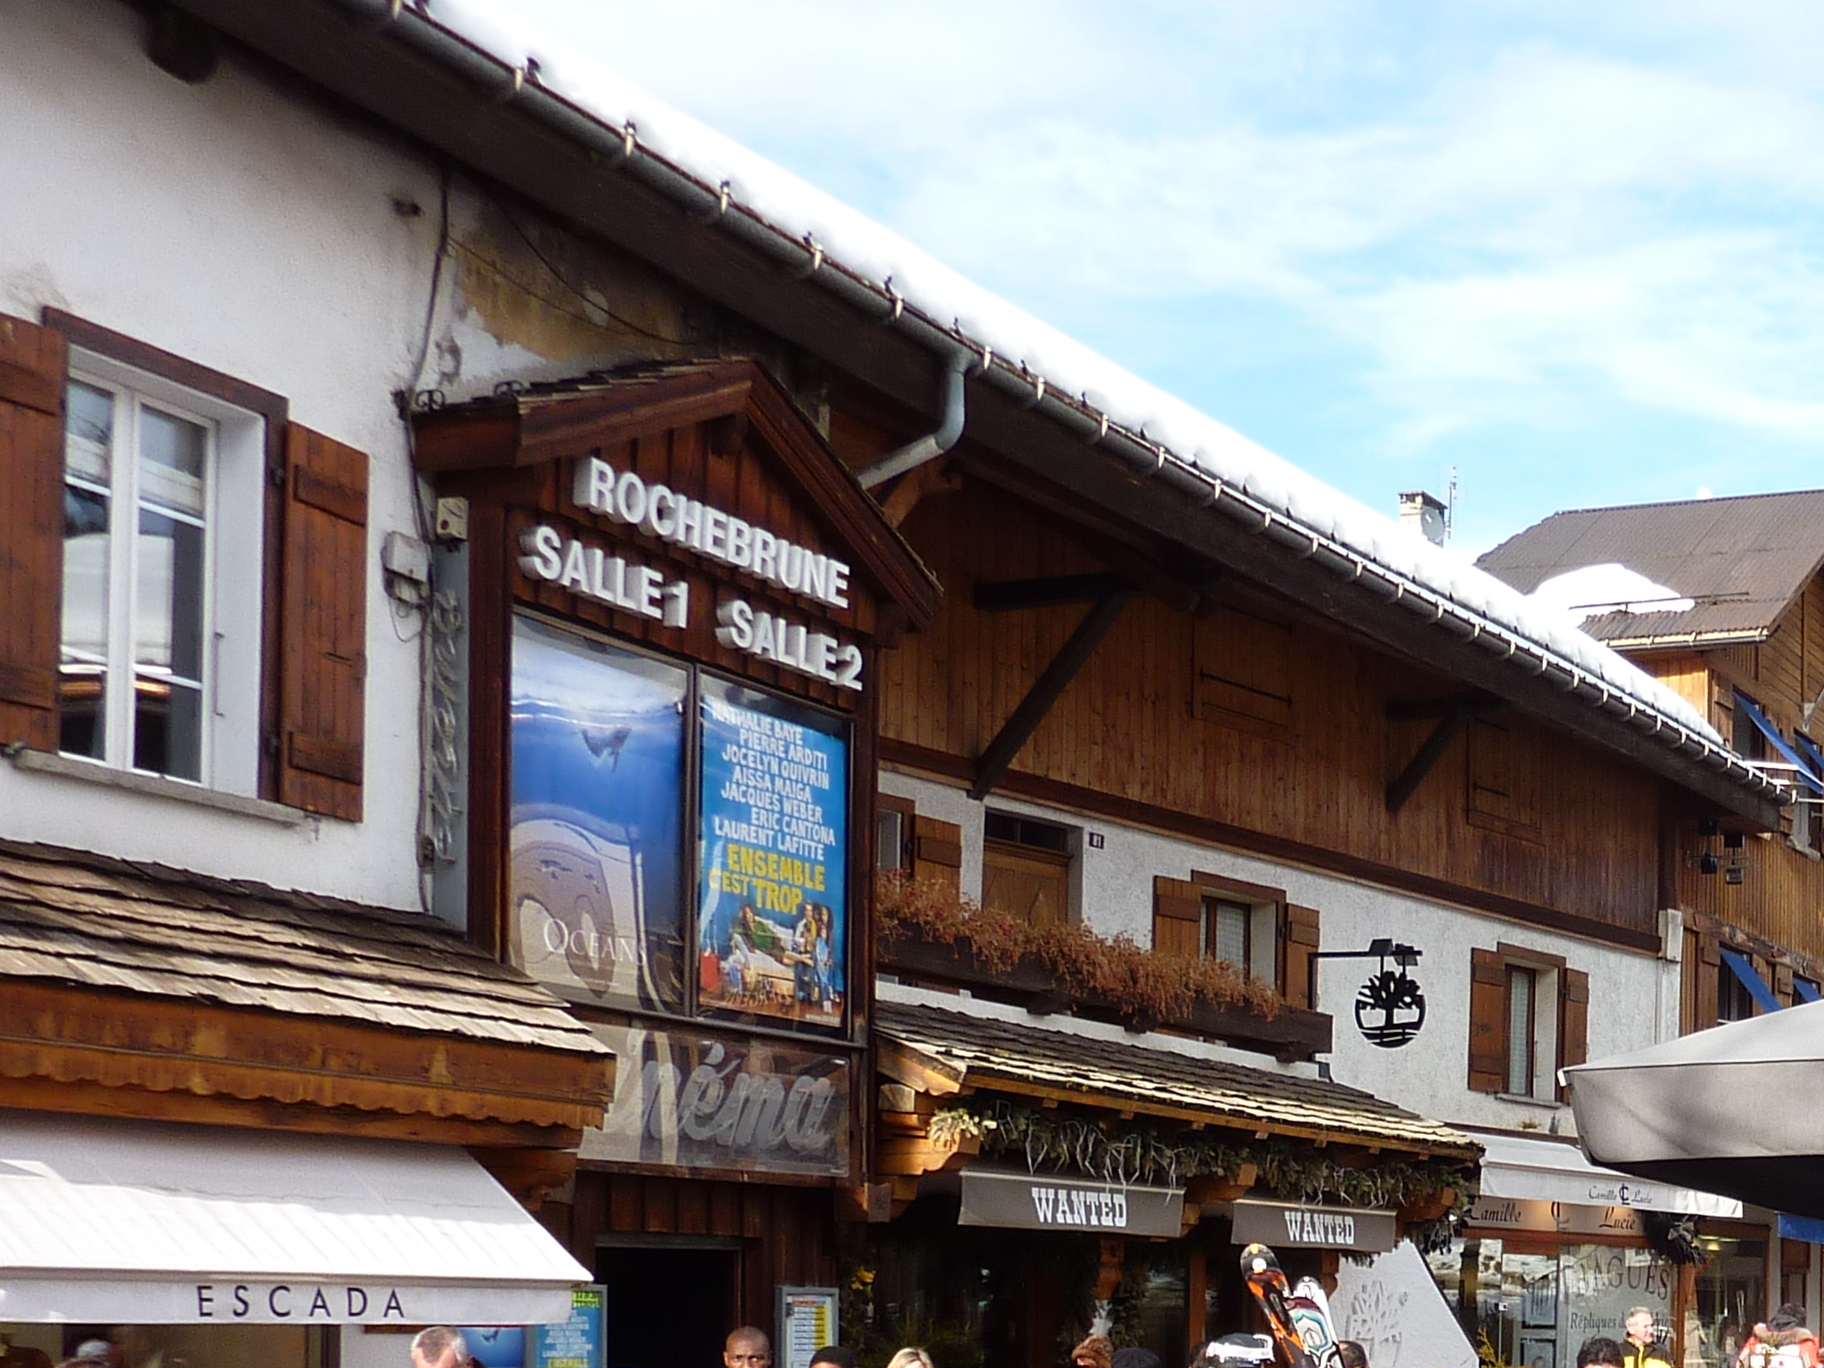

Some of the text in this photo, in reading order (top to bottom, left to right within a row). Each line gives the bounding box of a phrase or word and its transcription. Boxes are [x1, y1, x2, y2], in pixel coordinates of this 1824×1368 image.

[575, 456, 850, 609] ROCHEBRUNE
[740, 728, 828, 771] PIERRE ARDITI
[774, 721, 804, 745] BAYE
[722, 743, 830, 790] JOCELYN QUIVRIN
[721, 782, 823, 824] JACQUES WEBER
[714, 816, 825, 862] LAURENT LAFITTE
[751, 807, 836, 847] ERIC CANTONA
[727, 843, 826, 893] ENSEMBLE
[752, 878, 804, 916] TROP
[1031, 1187, 1127, 1228] WANTED
[1597, 1205, 1636, 1231] Lucie
[1284, 1211, 1355, 1245] WANTED
[197, 1284, 407, 1319] ESCADA
[1570, 1312, 1618, 1332] Répliques
